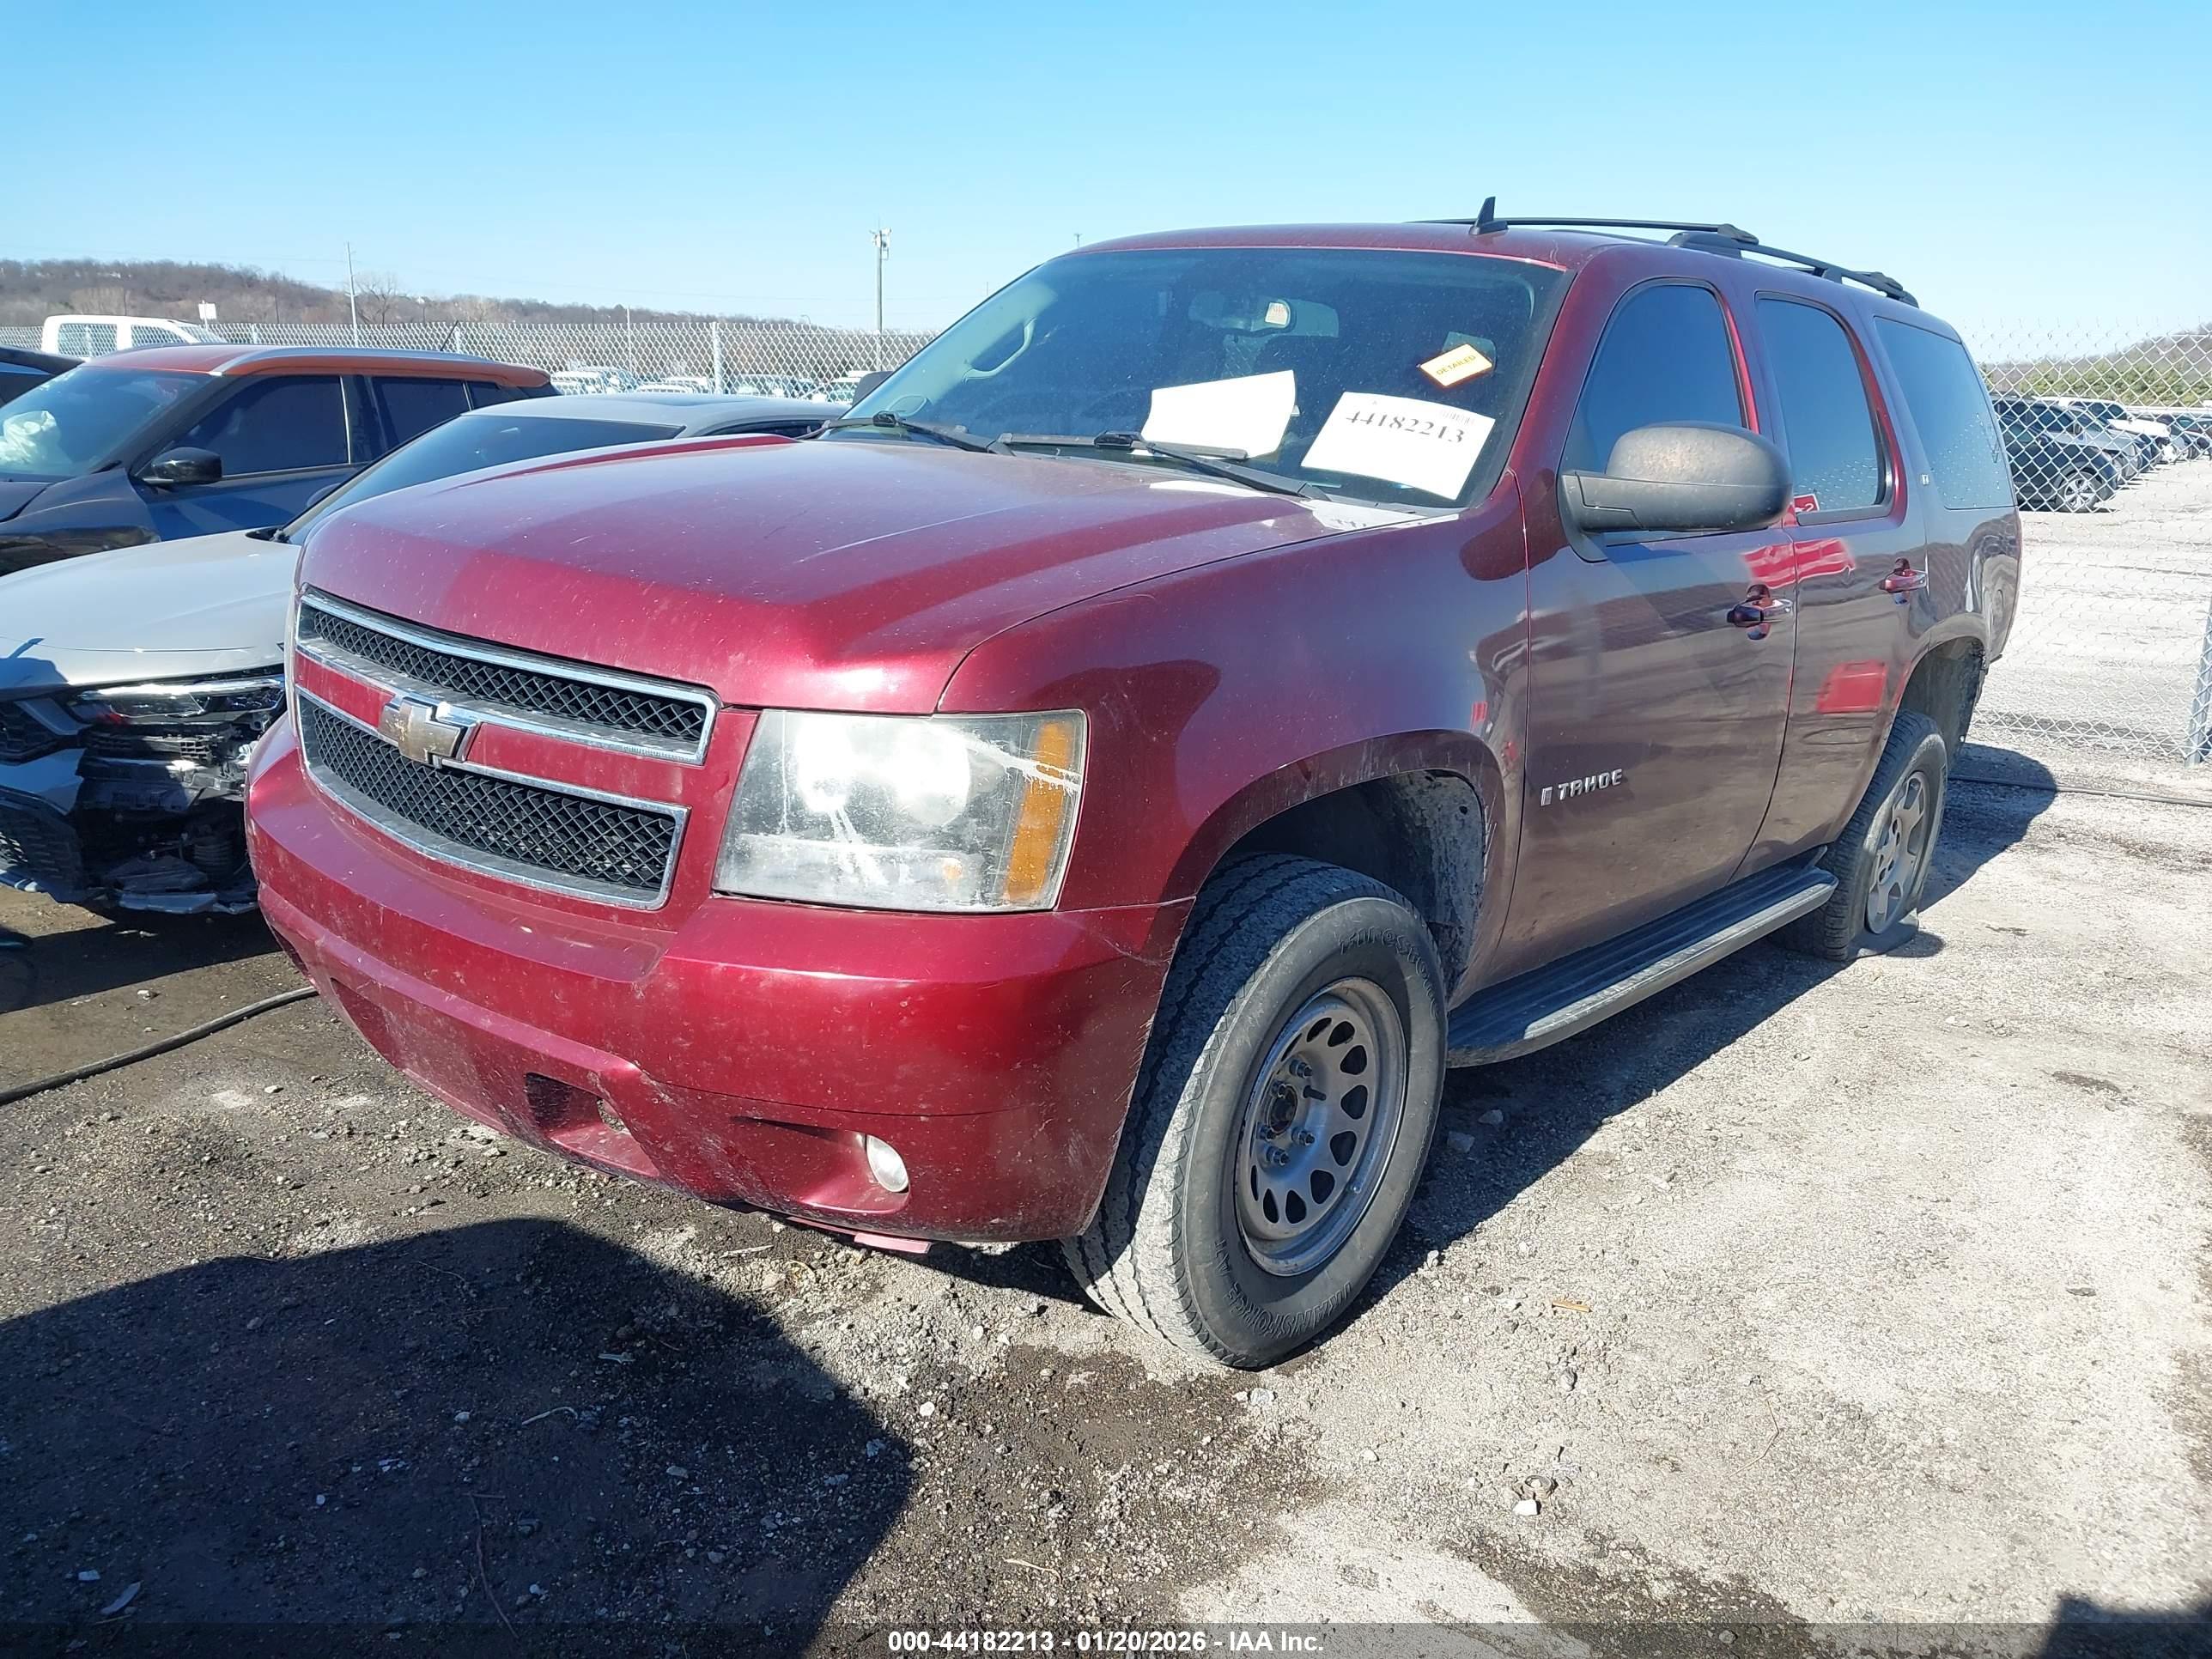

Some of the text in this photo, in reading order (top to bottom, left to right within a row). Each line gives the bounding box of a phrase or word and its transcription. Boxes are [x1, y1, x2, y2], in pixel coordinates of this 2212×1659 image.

[1437, 355, 1476, 375] DETAILED
[1346, 410, 1464, 443] 44182213
[1558, 769, 1622, 800] TAHOE
